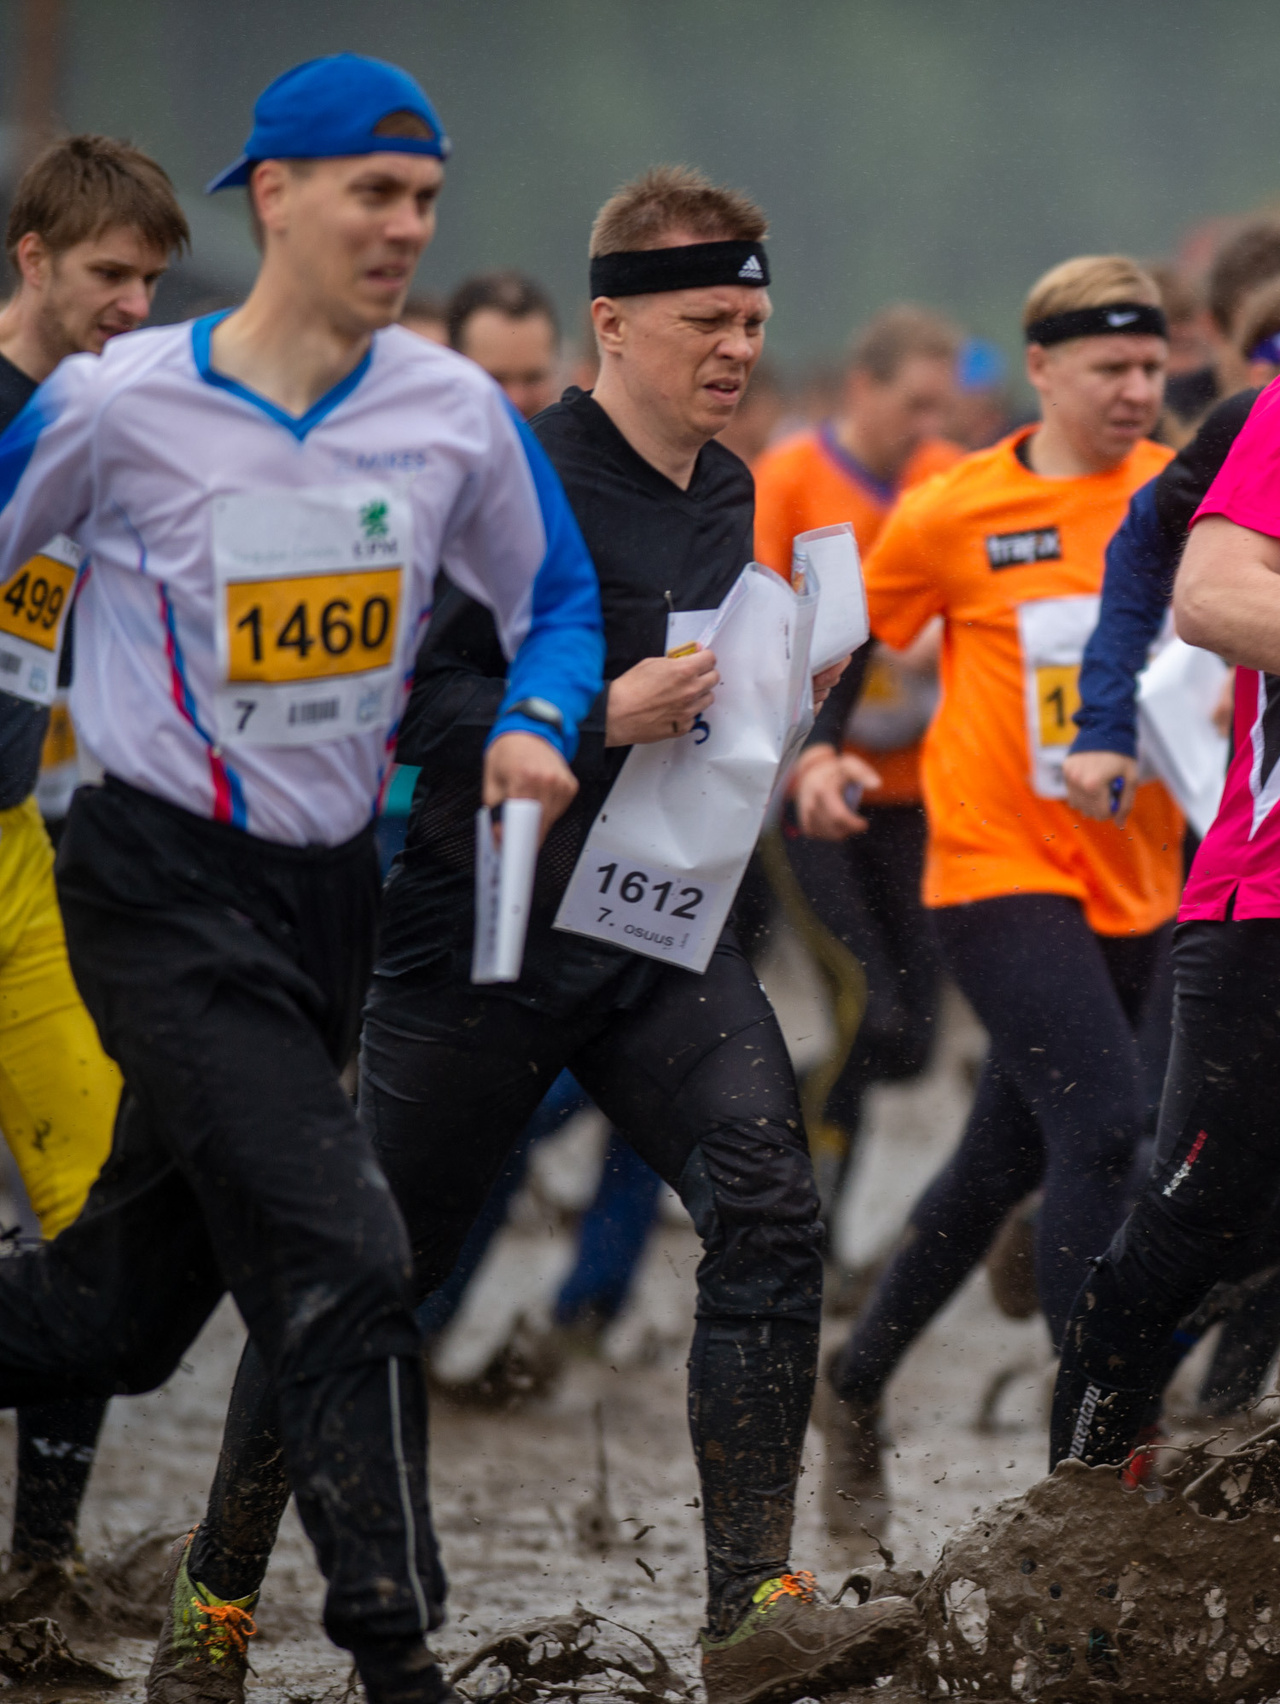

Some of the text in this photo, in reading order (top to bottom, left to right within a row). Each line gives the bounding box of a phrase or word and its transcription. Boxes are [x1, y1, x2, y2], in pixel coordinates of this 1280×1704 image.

[5, 571, 64, 630] 499
[236, 595, 391, 662] 1460
[235, 700, 257, 732] 7
[597, 862, 704, 920] 1612
[596, 907, 614, 927] 7.
[624, 924, 675, 946] osuus
[1068, 1384, 1102, 1458] nonam
